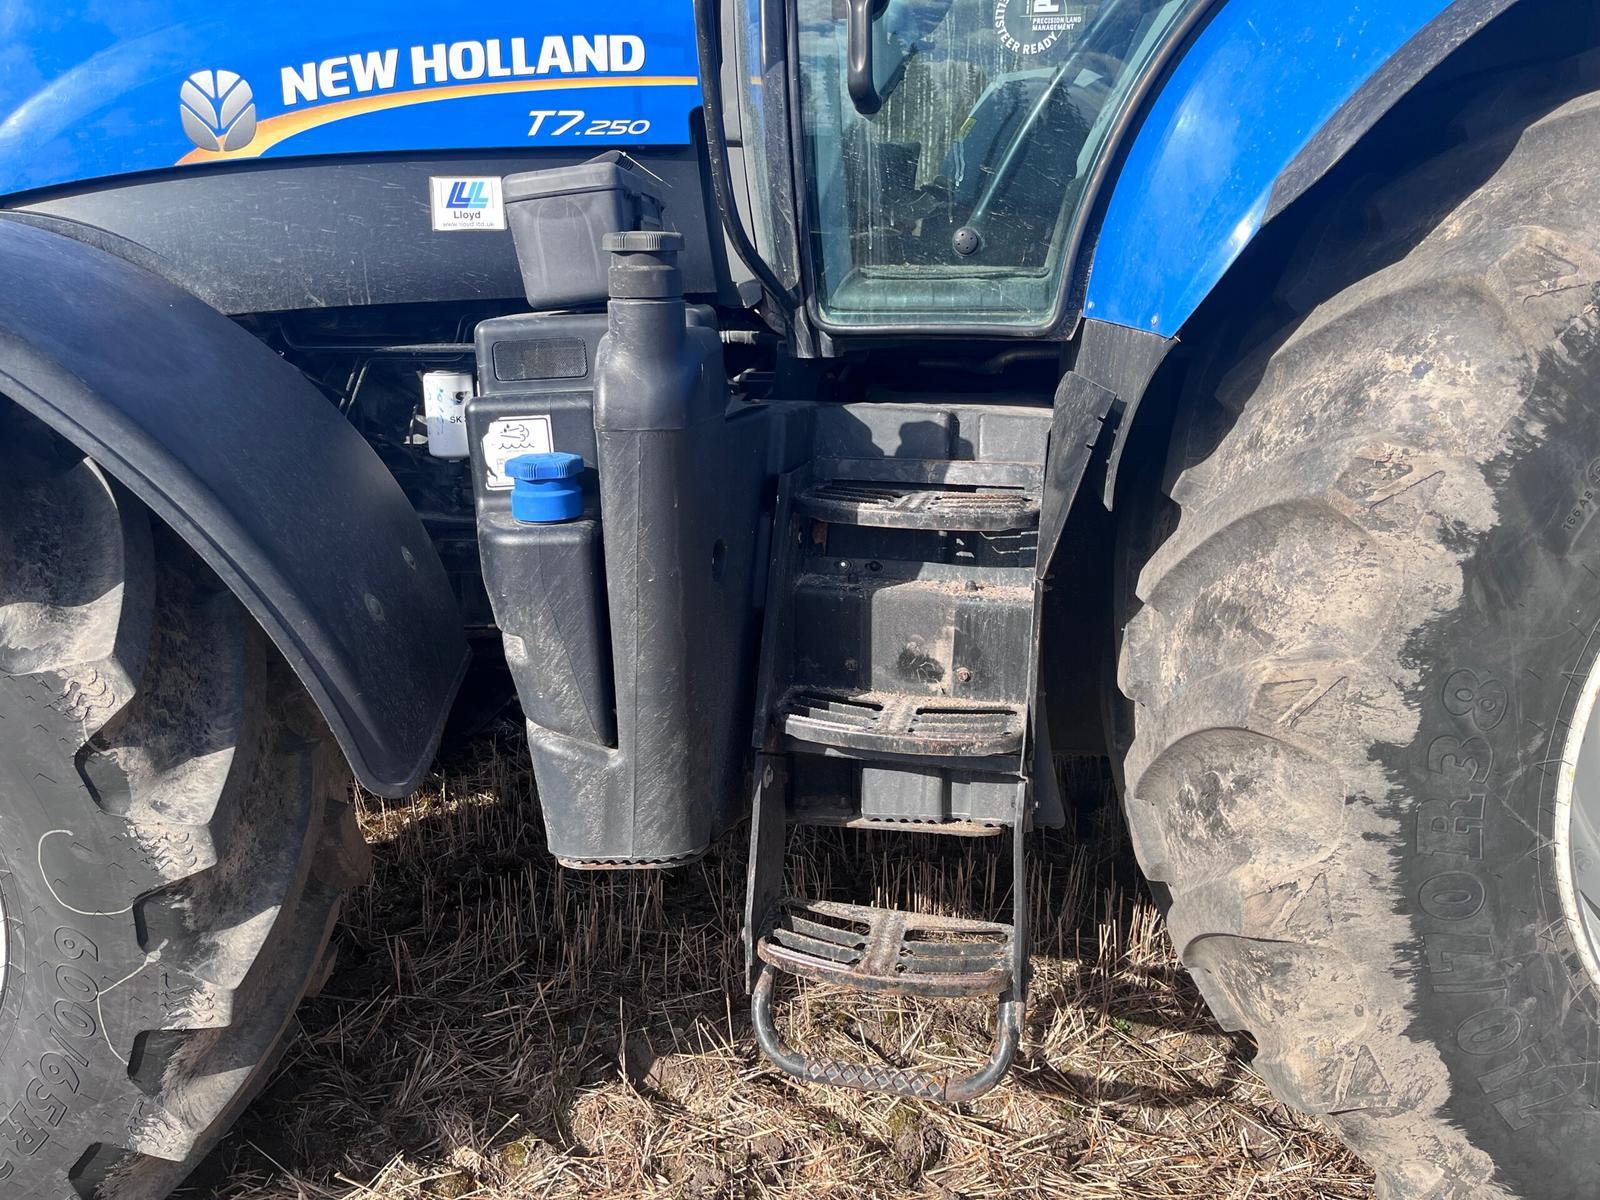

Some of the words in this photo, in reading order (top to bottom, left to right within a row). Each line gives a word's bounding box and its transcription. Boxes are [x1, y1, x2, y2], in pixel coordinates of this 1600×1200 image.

[1032, 23, 1075, 31] MANAGEMENT
[1022, 31, 1057, 55] READY
[281, 48, 398, 106] NEW
[410, 34, 646, 85] HOLLAND
[528, 110, 651, 136] T7.250
[453, 210, 481, 221] Lloyd
